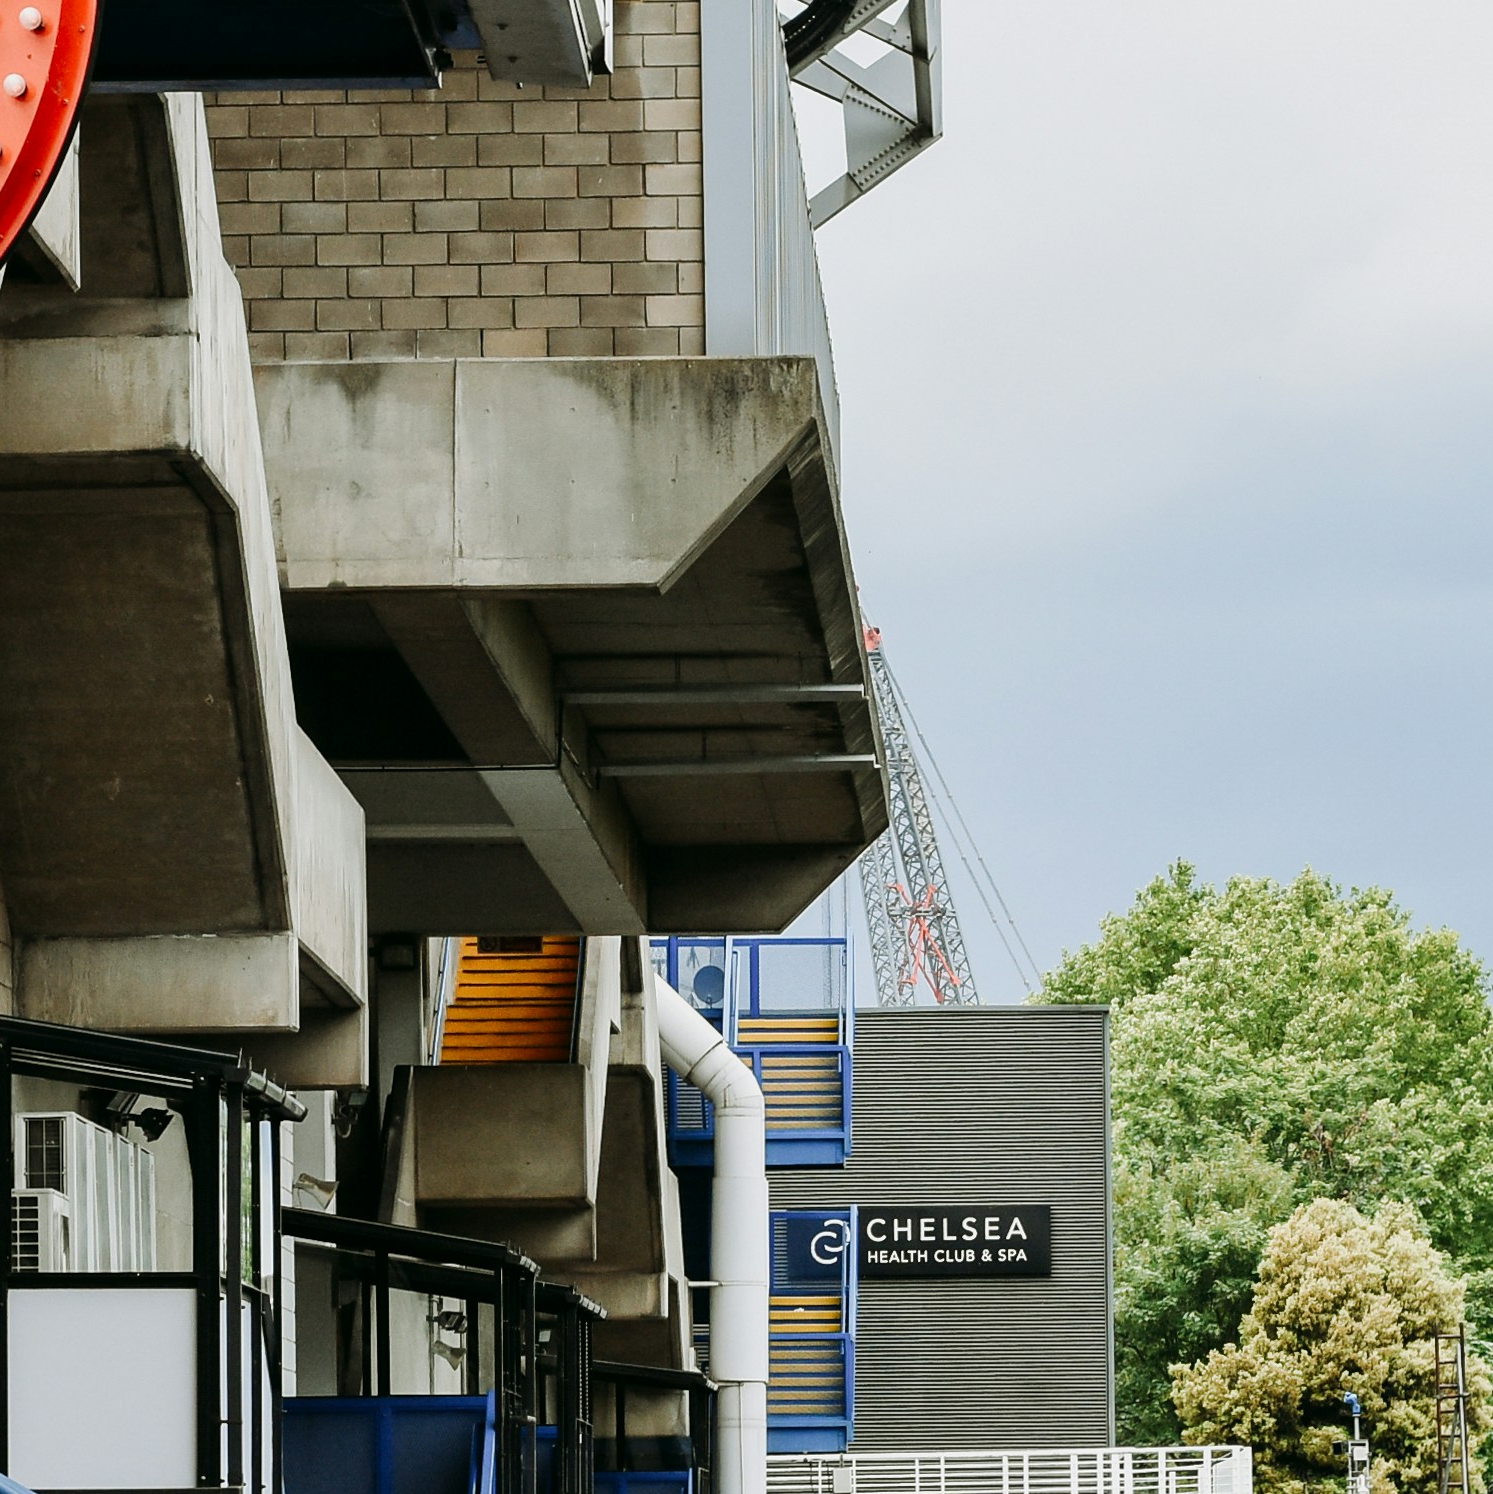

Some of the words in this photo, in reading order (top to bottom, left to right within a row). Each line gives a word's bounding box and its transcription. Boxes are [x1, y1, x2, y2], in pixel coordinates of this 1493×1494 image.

[866, 1217, 1027, 1241] CHELSEA
[867, 1250, 928, 1263] HEALTH
[934, 1249, 975, 1262] CLUB
[981, 1249, 993, 1261] &
[998, 1249, 1027, 1261] SPA
